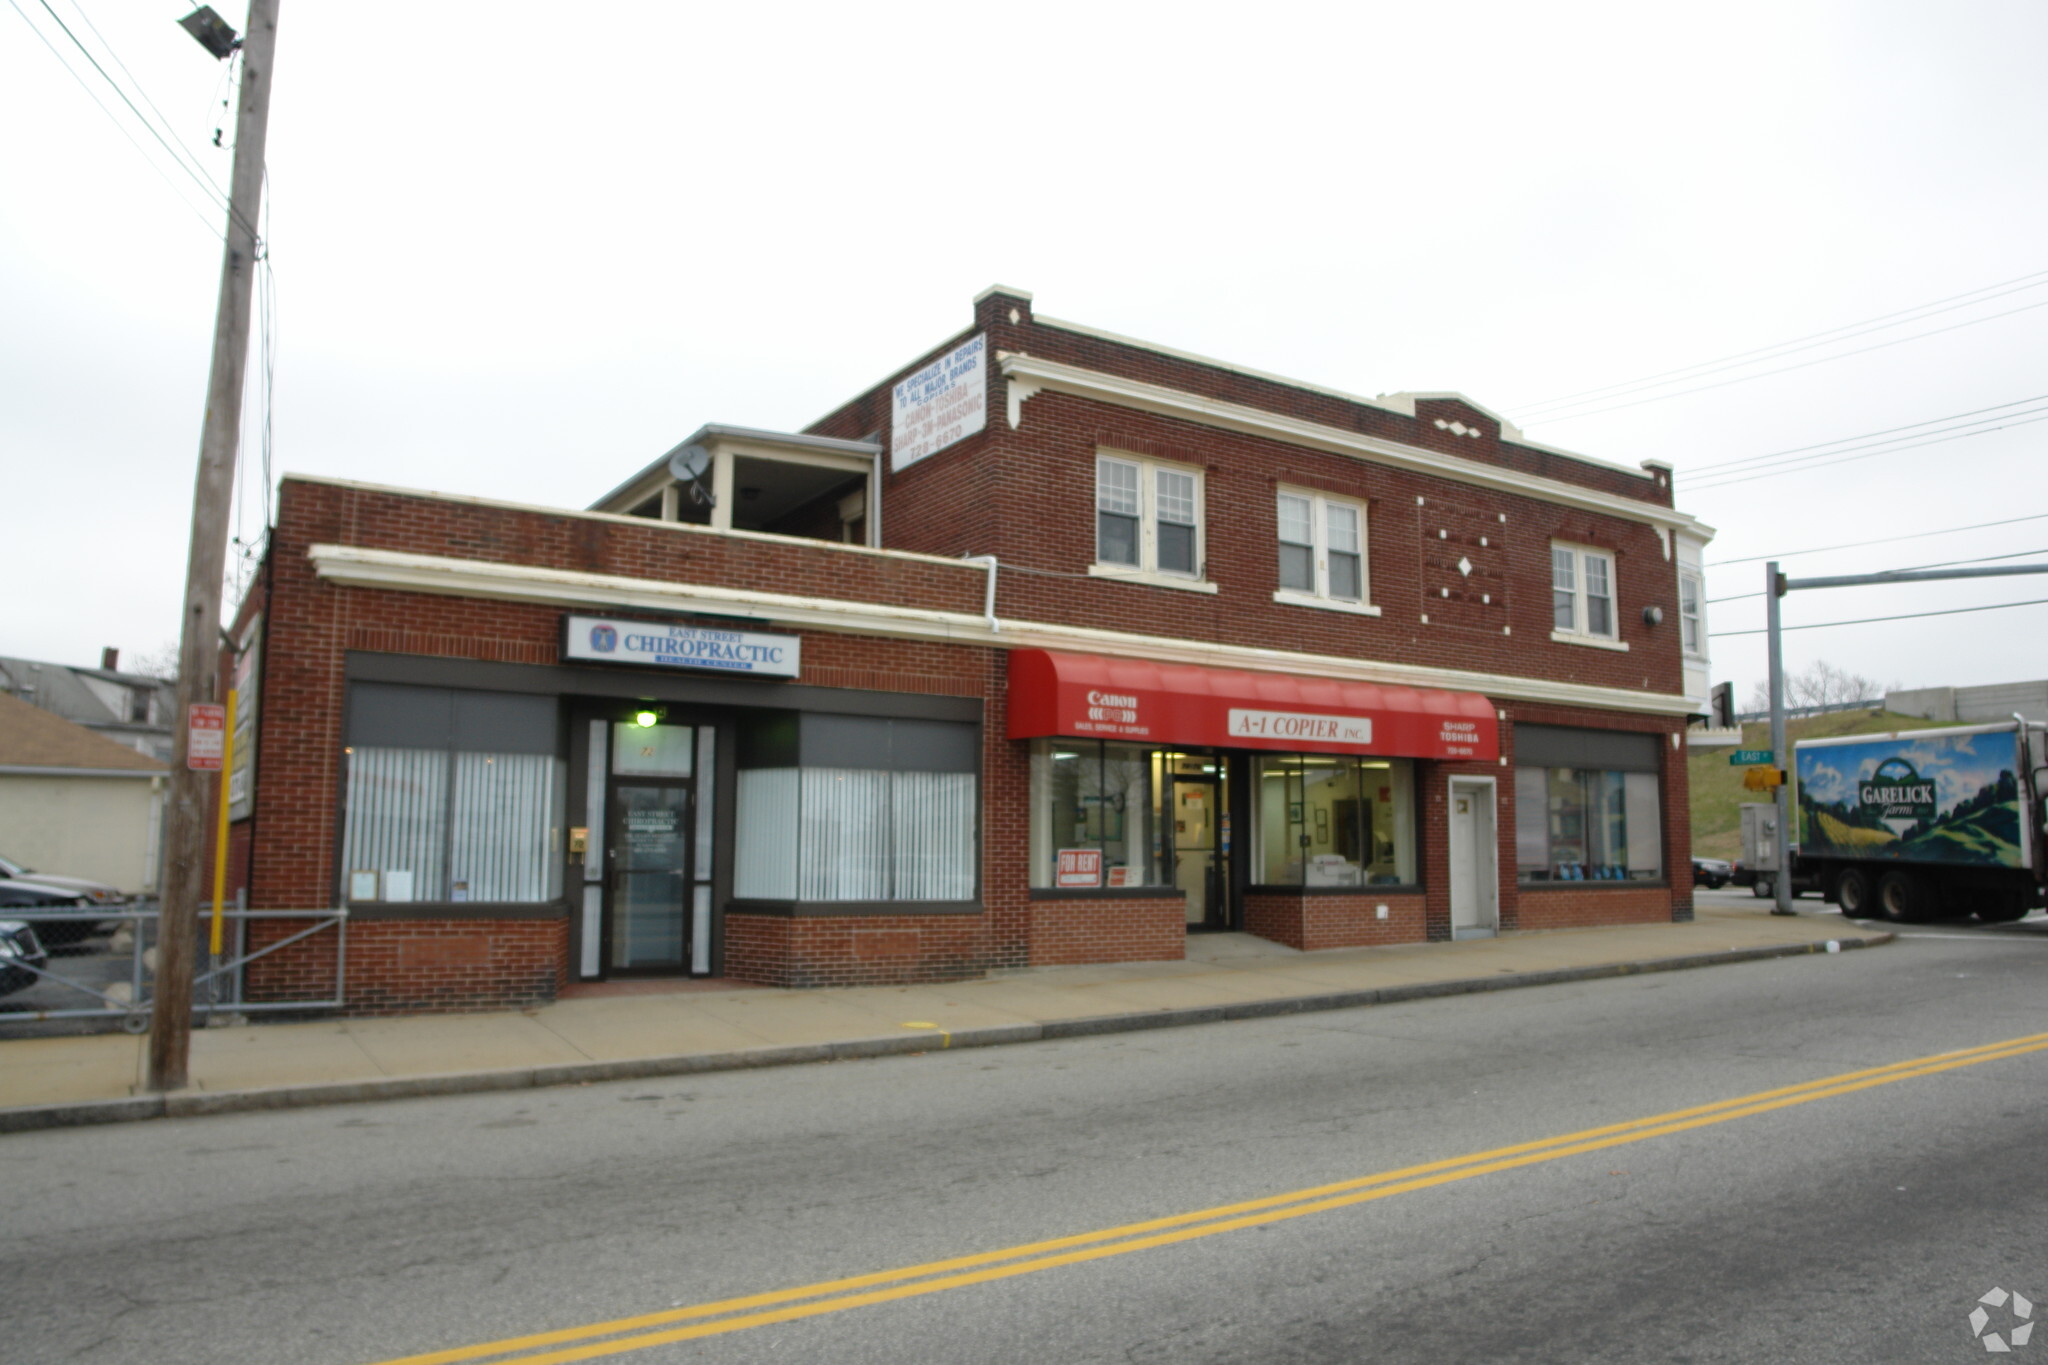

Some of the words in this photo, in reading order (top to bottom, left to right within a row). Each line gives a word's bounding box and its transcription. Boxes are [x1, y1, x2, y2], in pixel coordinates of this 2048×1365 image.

[907, 362, 942, 393] SPECIALIZE
[945, 357, 951, 371] IN
[955, 339, 983, 365] REPAIRS
[900, 395, 907, 409] TO
[911, 387, 920, 403] ALL
[925, 373, 946, 396] MAJOR
[950, 355, 977, 382] BRANDS
[917, 381, 957, 407] COPIERS
[669, 627, 698, 639] EAST
[701, 630, 744, 644] STREET
[624, 633, 783, 664] CHIROPRACTIC
[1087, 689, 1137, 709] Canon
[1239, 714, 1267, 734] A-1
[1273, 716, 1339, 738] COPIER
[1443, 721, 1476, 732] SHARP
[1440, 731, 1479, 743] TOSHIBA
[1741, 751, 1760, 761] EAST
[1862, 785, 1933, 804] GARELICK
[1881, 802, 1914, 819] Farms
[1061, 853, 1075, 873] FOR
[1078, 853, 1098, 873] RENT
